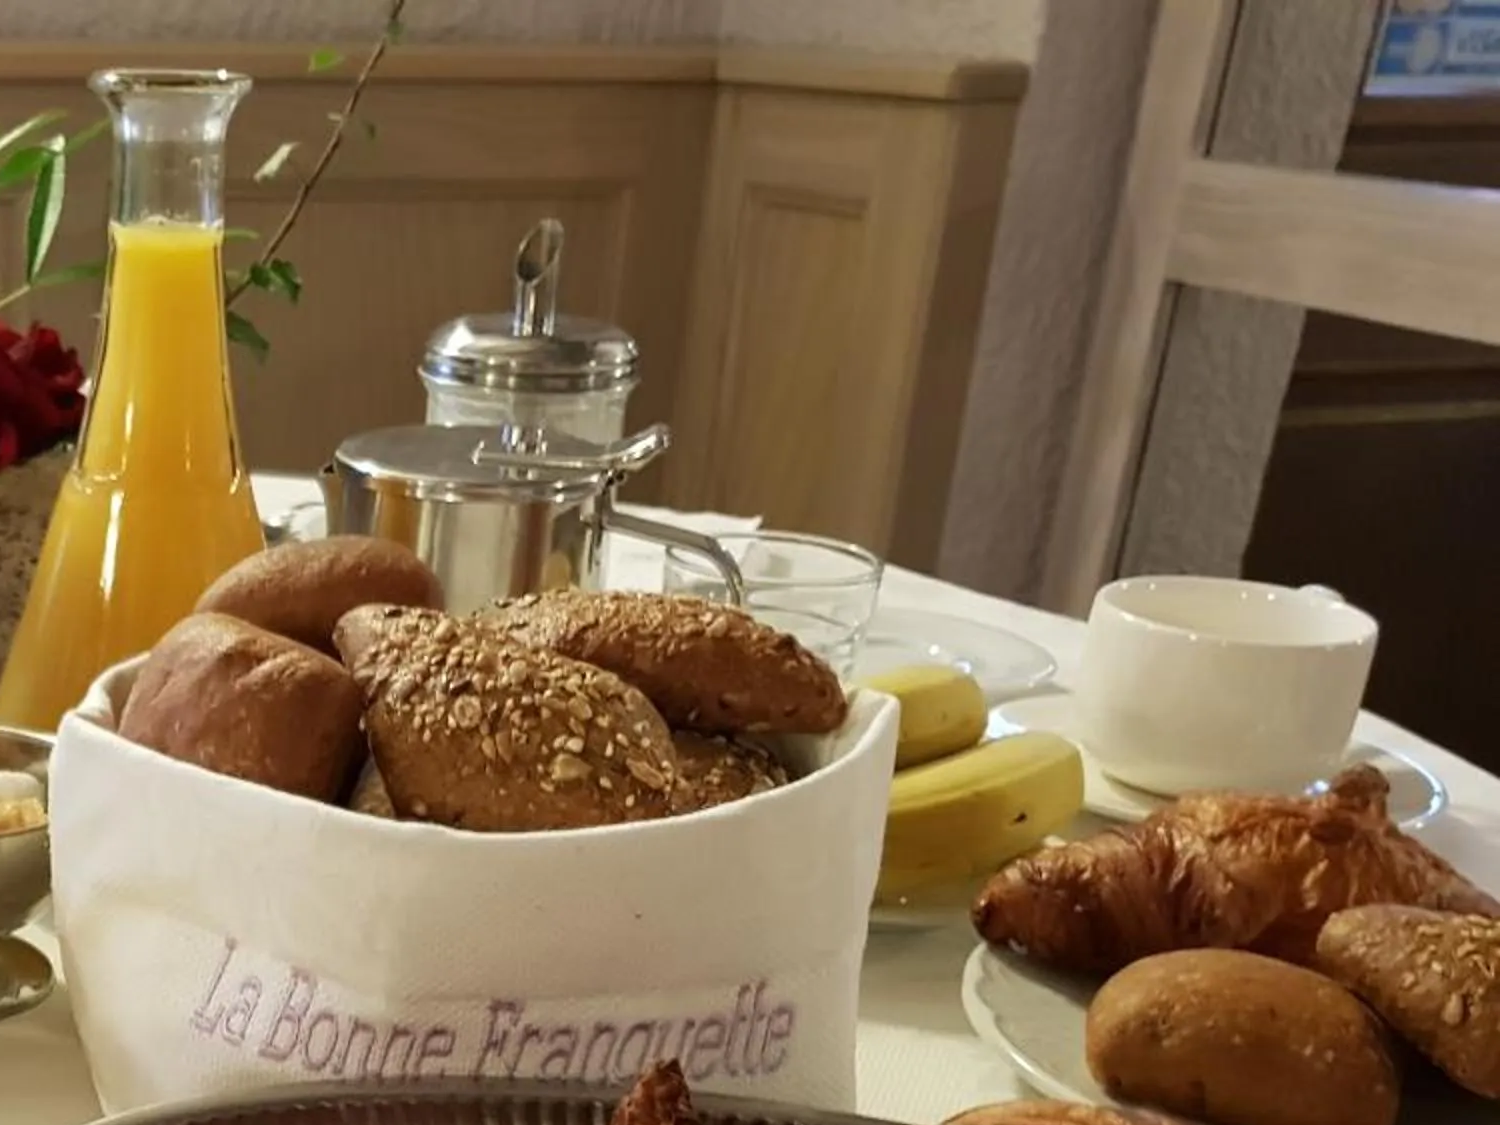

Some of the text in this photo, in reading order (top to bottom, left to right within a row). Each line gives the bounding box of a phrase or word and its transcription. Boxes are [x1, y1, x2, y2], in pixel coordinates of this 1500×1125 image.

[190, 935, 795, 1084] La Bonne Franquette
